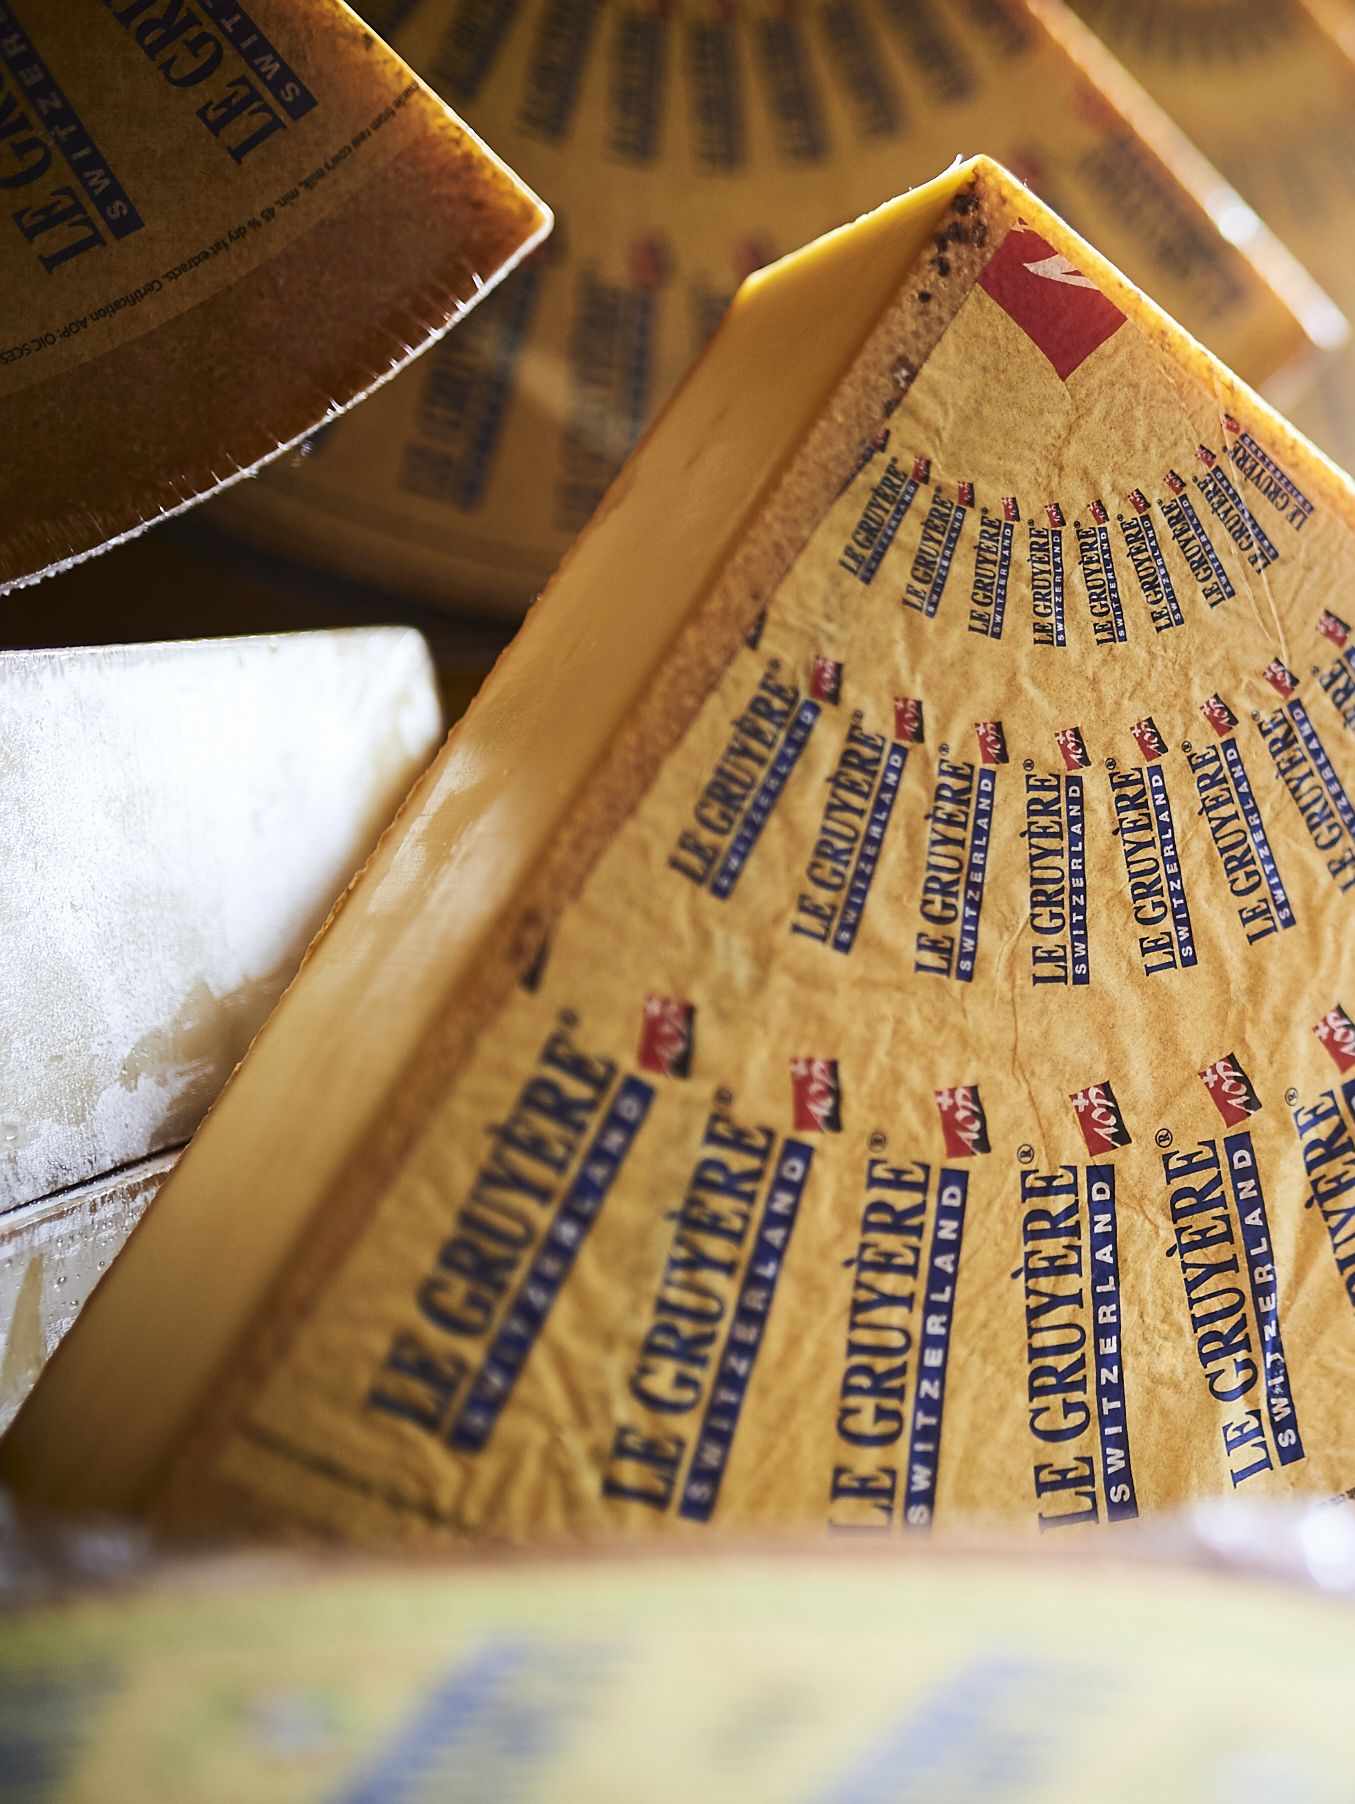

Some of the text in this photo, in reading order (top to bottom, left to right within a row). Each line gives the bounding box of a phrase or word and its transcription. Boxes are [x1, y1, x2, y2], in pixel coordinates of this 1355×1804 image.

[196, 75, 287, 165] LE
[11, 186, 107, 274] LE
[210, 239, 228, 255] fat
[228, 223, 248, 243] dry
[57, 317, 87, 338] AOP:
[90, 279, 163, 321] Certification
[31, 333, 57, 352] OIC
[993, 528, 1011, 634] SWITZERLAND
[1100, 532, 1126, 637] SWITZERLAND
[1144, 521, 1182, 621] SWITZERLAND
[1182, 500, 1233, 594] SWITZERLAND
[902, 584, 926, 612] LE
[968, 610, 991, 637] LE
[1054, 535, 1064, 641] SWITZERLAND
[1150, 607, 1173, 633] LE
[1202, 582, 1226, 609] LE
[1033, 621, 1054, 646] LE
[1093, 621, 1116, 645] LE
[667, 830, 720, 887] LE
[836, 754, 903, 943] SWITZERLAND
[1151, 774, 1193, 958] SWITZERLAND
[1226, 748, 1291, 920] SWITZERLAND
[960, 778, 992, 971] SWITZERLAND
[1069, 785, 1087, 974] SWITZERLAND
[790, 893, 837, 943] LE
[914, 932, 954, 978] LE
[1139, 931, 1177, 977] LE
[1238, 898, 1278, 945] LE
[1032, 944, 1067, 986] LE
[907, 1183, 962, 1523] SWITZERLAND
[1092, 1180, 1131, 1503] SWITZERLAND
[367, 1330, 469, 1434] LE
[603, 1424, 686, 1513] LE
[1222, 1408, 1274, 1488] LE
[827, 1464, 898, 1538] LE
[1034, 1455, 1100, 1534] LE
